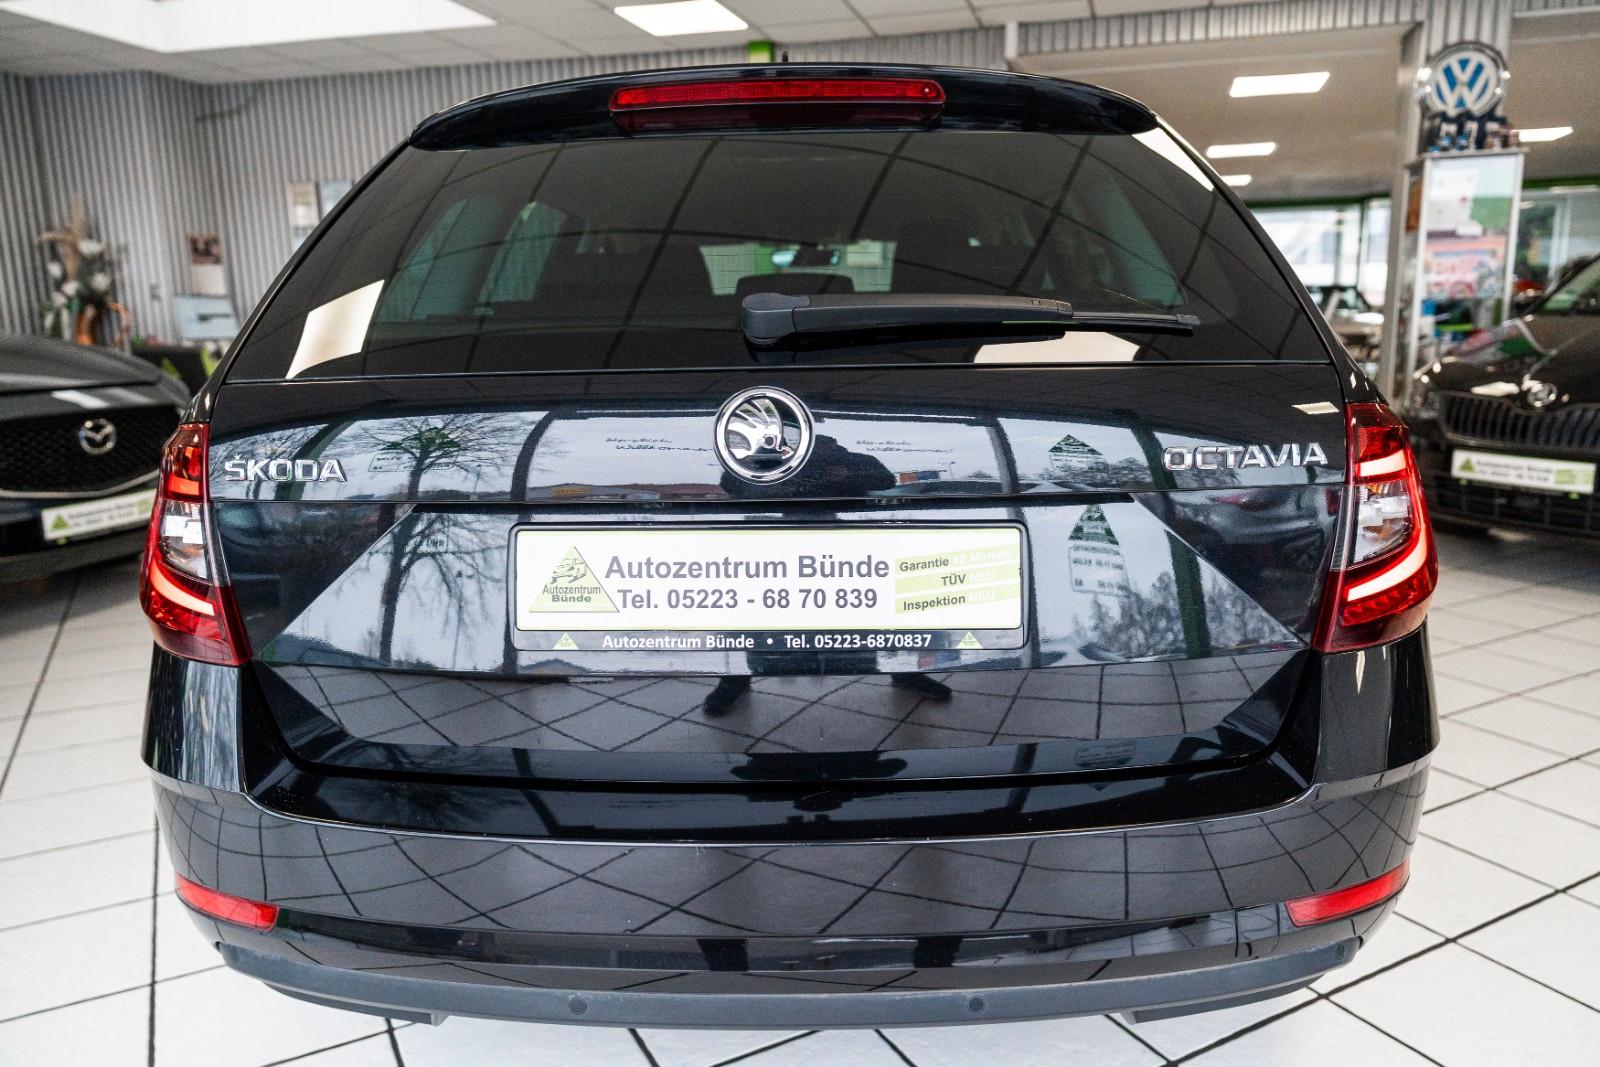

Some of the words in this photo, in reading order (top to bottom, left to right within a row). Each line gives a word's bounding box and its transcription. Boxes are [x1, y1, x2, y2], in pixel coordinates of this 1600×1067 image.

[1162, 442, 1328, 470] OCTAVIA
[224, 454, 347, 482] ŠKODA
[604, 556, 787, 579] Autozentrum
[798, 554, 890, 578] Bünde
[899, 557, 950, 572] Garantie
[941, 573, 966, 586] TÜV
[542, 584, 601, 594] Autozentrum
[551, 594, 592, 602] Bünde
[617, 589, 659, 609] Tel.
[667, 589, 738, 609] 05223
[762, 588, 790, 609] 68
[798, 588, 826, 609] 70
[835, 588, 878, 609] 839
[903, 595, 966, 611] Inspektion
[602, 634, 701, 649] Autozentrum
[706, 633, 754, 649] Bünde
[784, 634, 810, 648] Tel.
[814, 634, 932, 649] 05223-6870837
